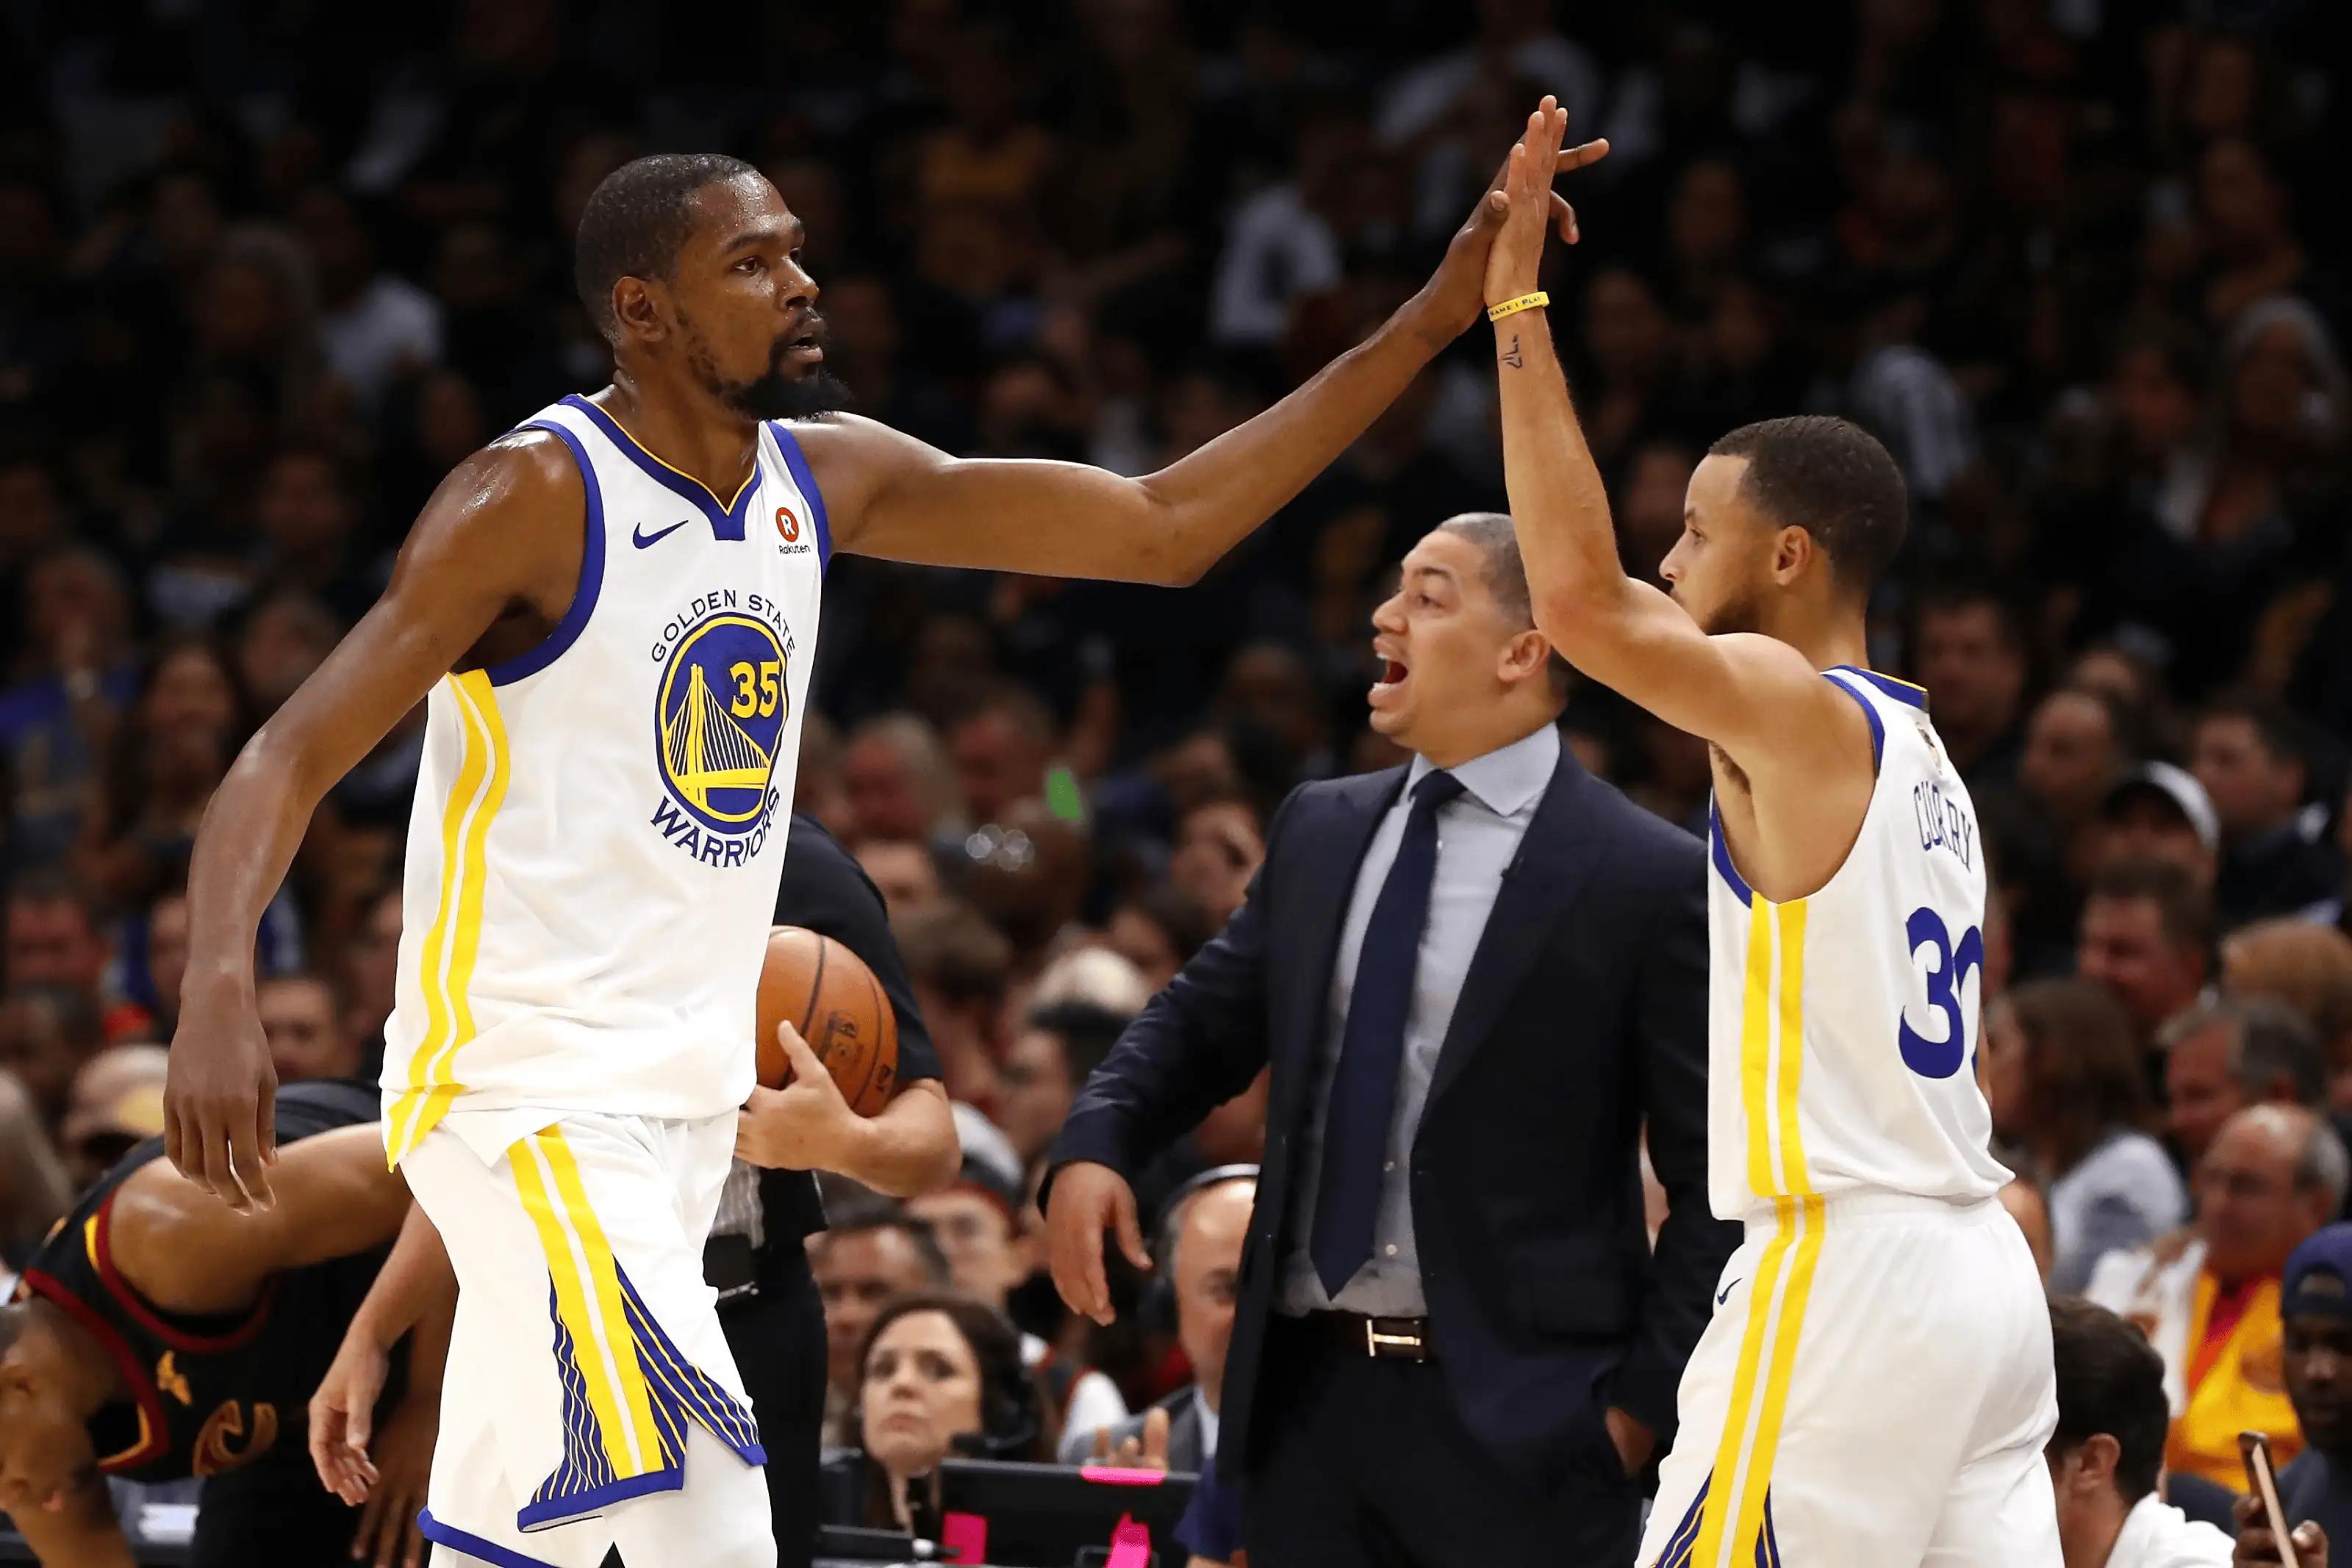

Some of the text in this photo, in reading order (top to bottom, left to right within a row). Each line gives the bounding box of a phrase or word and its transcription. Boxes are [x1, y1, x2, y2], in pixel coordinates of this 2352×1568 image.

[779, 544, 811, 554] Rakuten
[780, 514, 796, 535] R
[651, 589, 795, 662] GOLDEN STATE
[729, 659, 780, 718] 35
[650, 785, 780, 867] WARRIORS
[1914, 781, 1971, 873] CURRY
